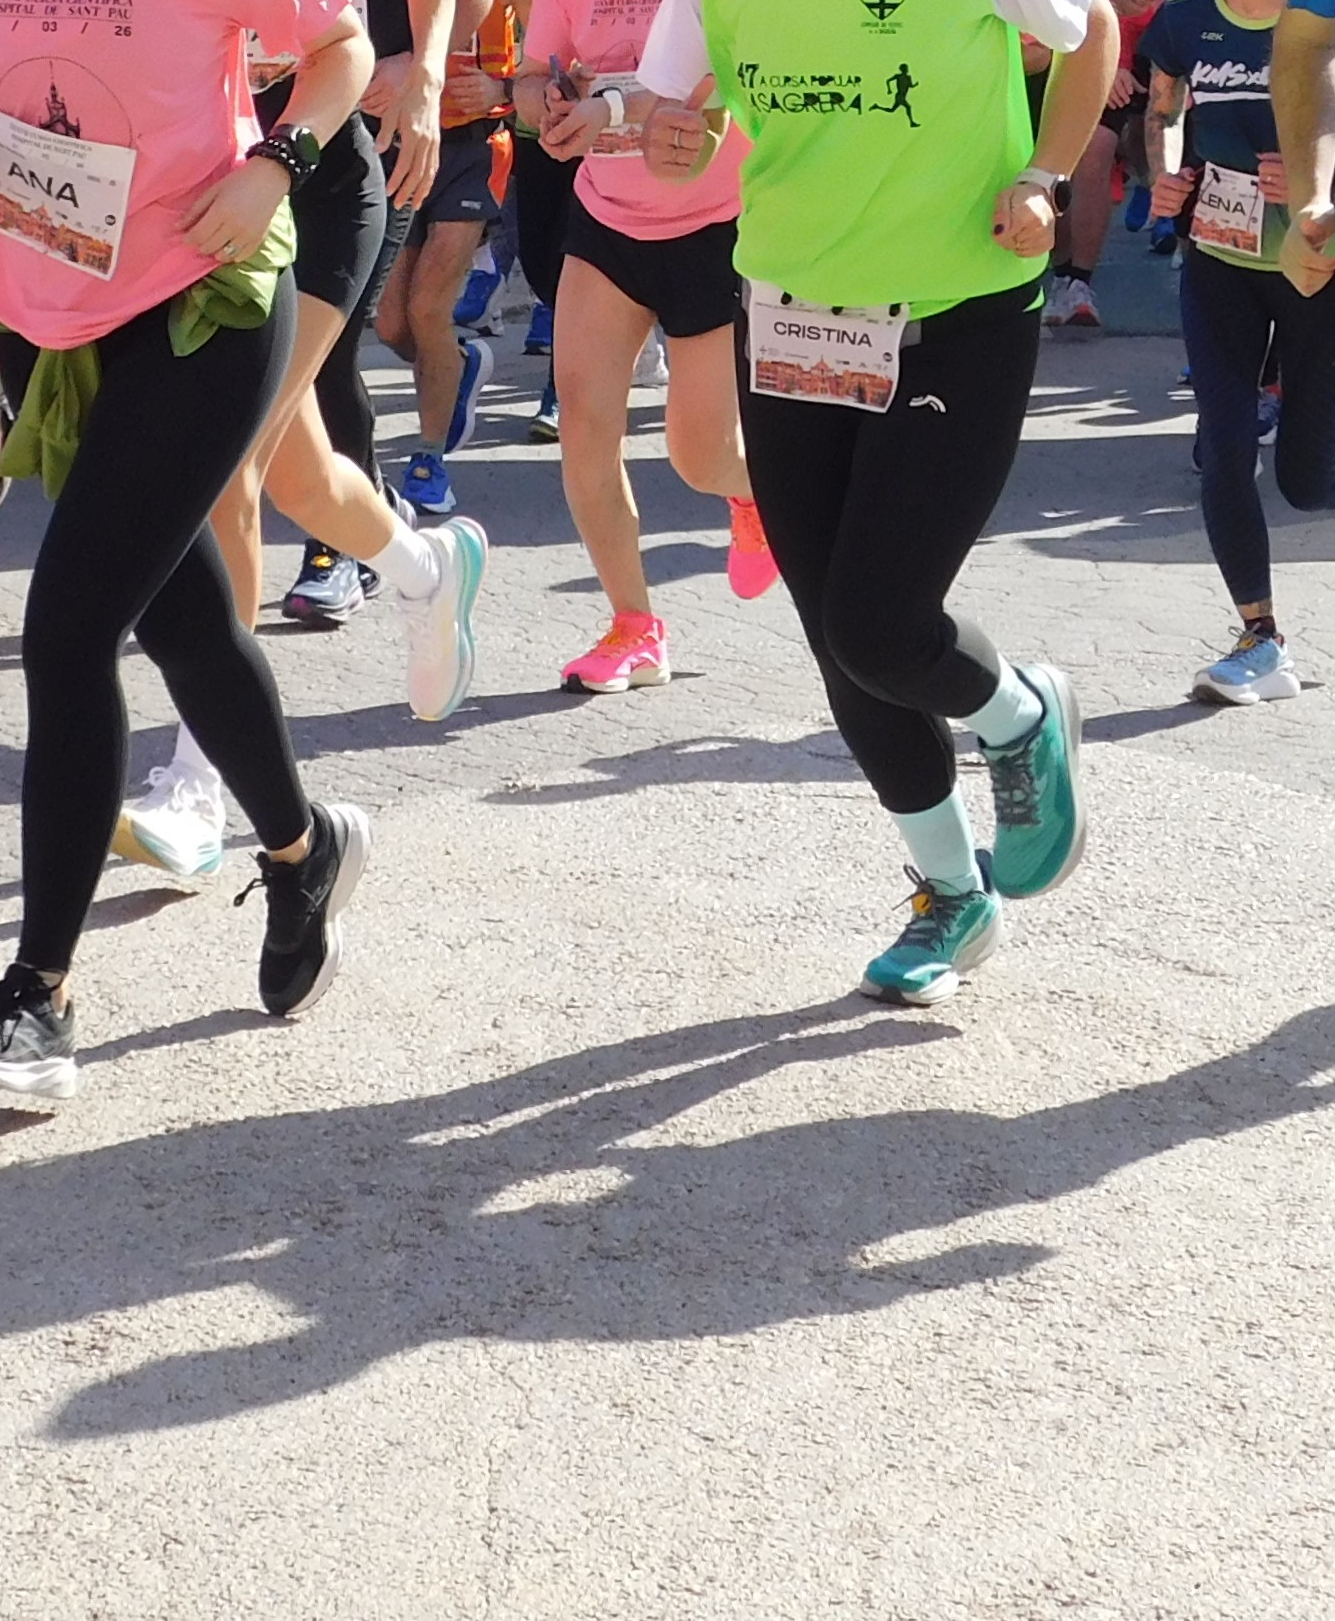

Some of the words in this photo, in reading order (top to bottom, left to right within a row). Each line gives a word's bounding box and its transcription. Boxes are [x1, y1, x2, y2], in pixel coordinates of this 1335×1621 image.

[68, 6, 101, 17] SANT
[108, 8, 132, 20] PAU
[41, 21, 58, 32] 03
[114, 25, 132, 37] 26
[770, 75, 808, 88] CURSA
[810, 75, 863, 88] POPULAR
[7, 161, 80, 208] ANA
[773, 322, 872, 348] CRISTINA
